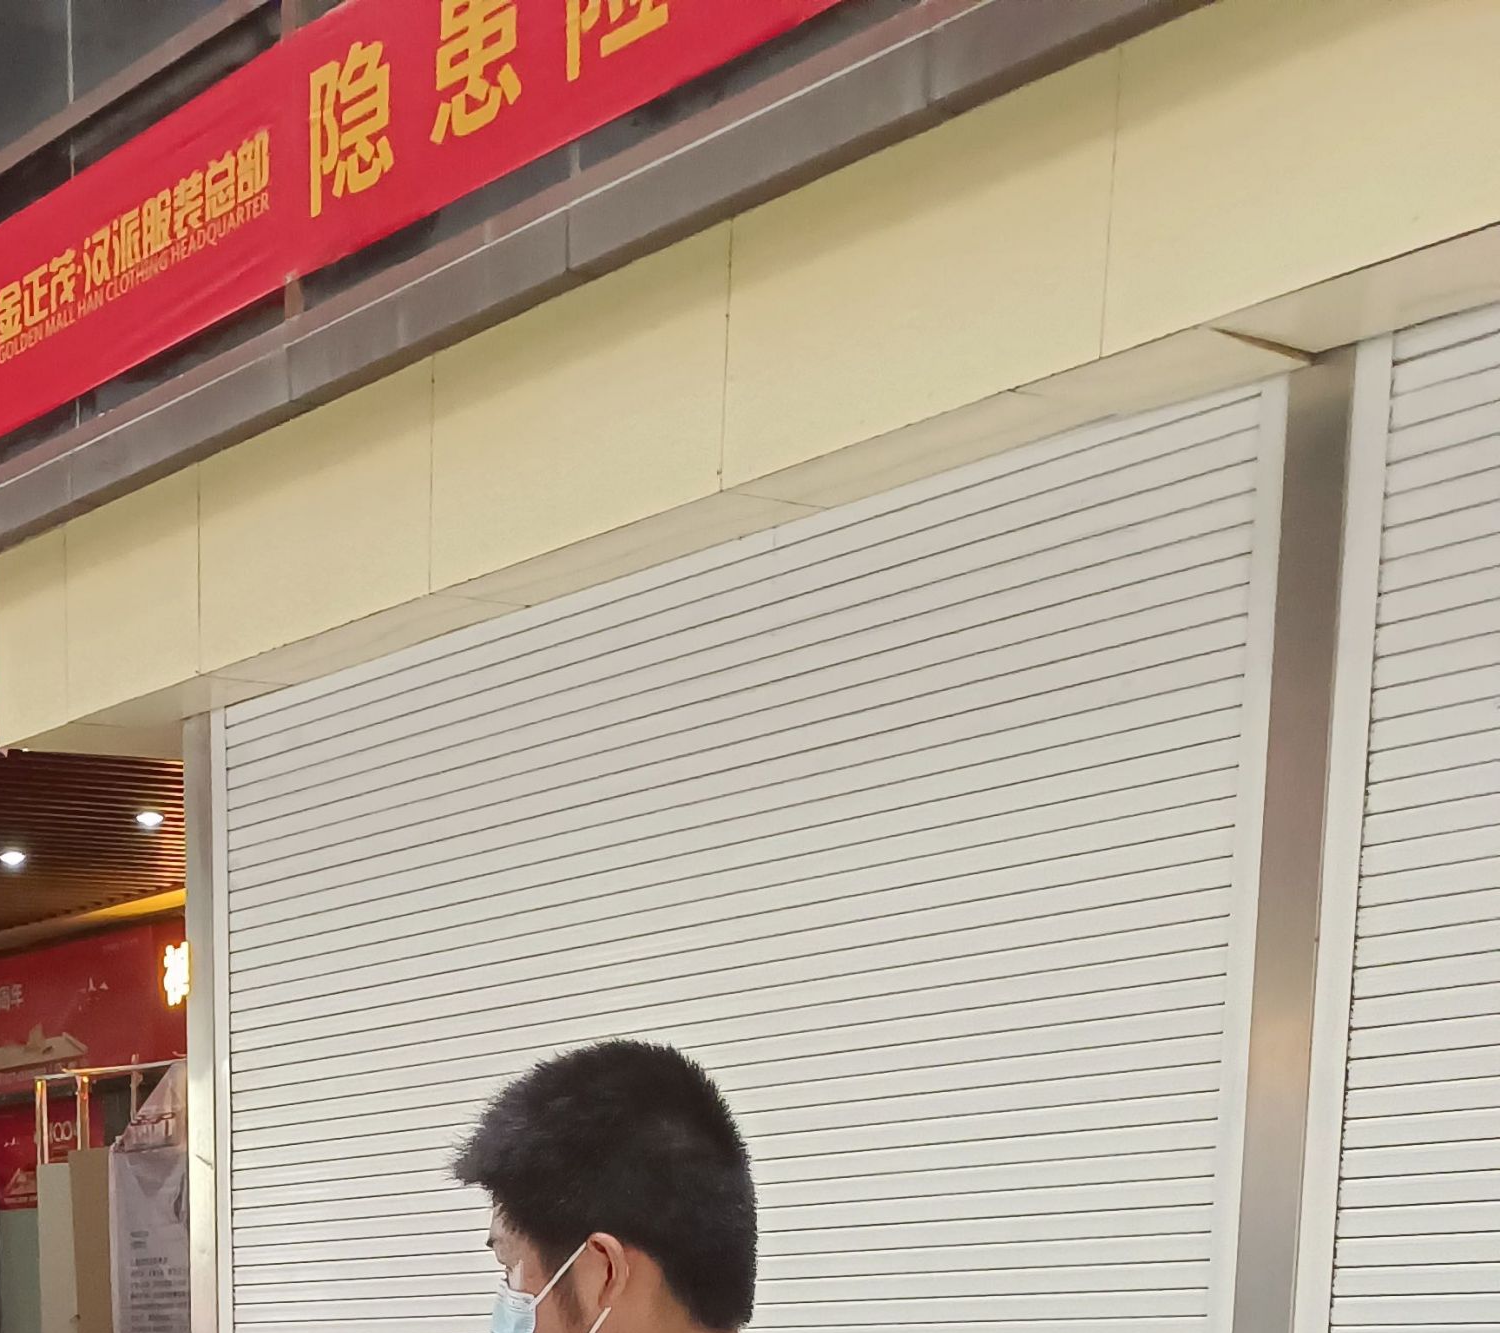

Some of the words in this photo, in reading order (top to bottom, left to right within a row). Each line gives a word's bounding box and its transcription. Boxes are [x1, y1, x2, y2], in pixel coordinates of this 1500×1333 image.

[46, 308, 77, 337] MALL
[77, 290, 104, 318] HAN
[105, 248, 169, 302] CLOTHING
[170, 192, 270, 262] HEADQUARTER
